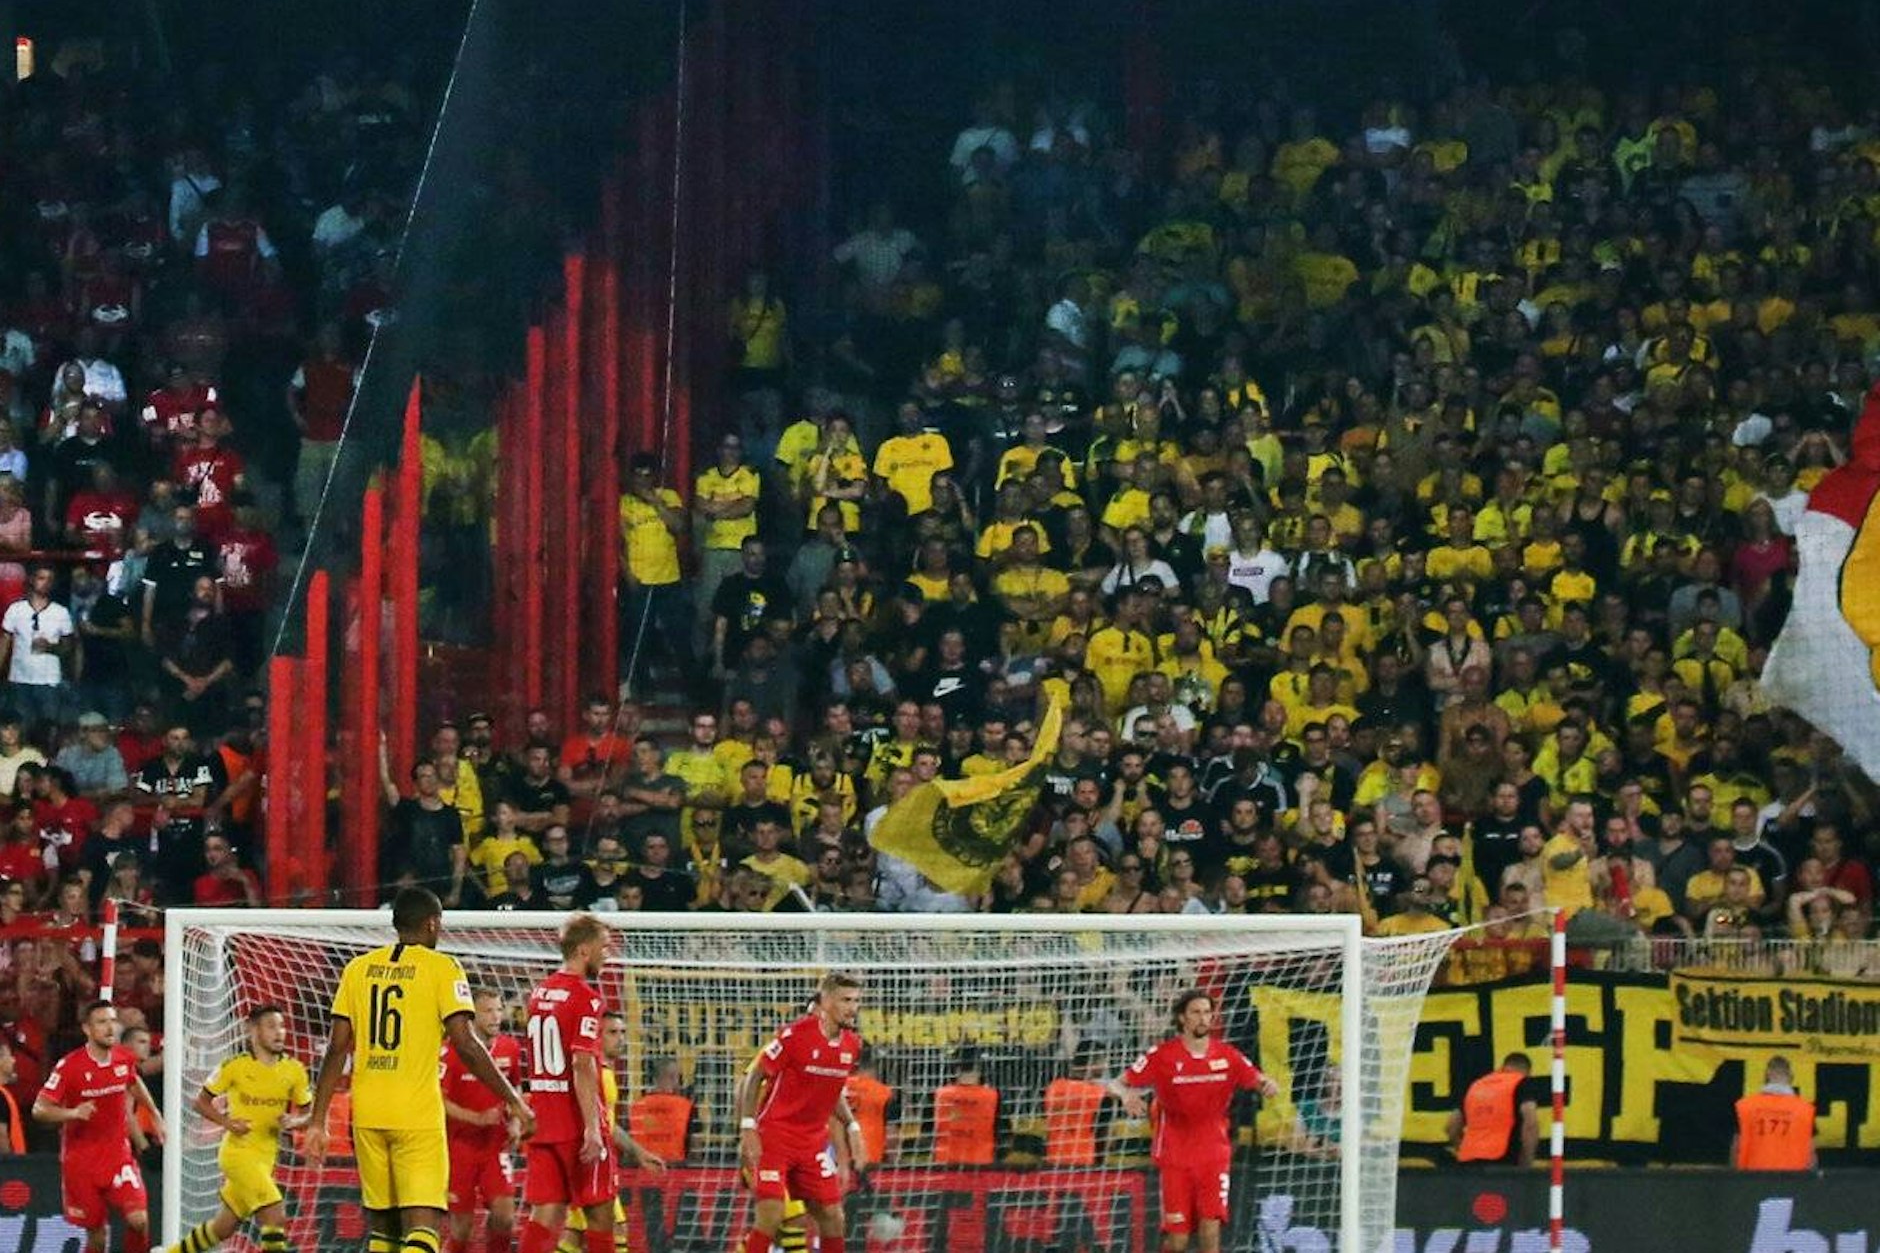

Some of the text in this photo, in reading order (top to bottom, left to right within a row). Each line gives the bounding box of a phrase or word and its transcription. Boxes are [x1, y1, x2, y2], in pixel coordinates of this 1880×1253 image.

[368, 983, 404, 1051] 16
[1676, 983, 1774, 1033] Sektion
[526, 1014, 566, 1077] 10
